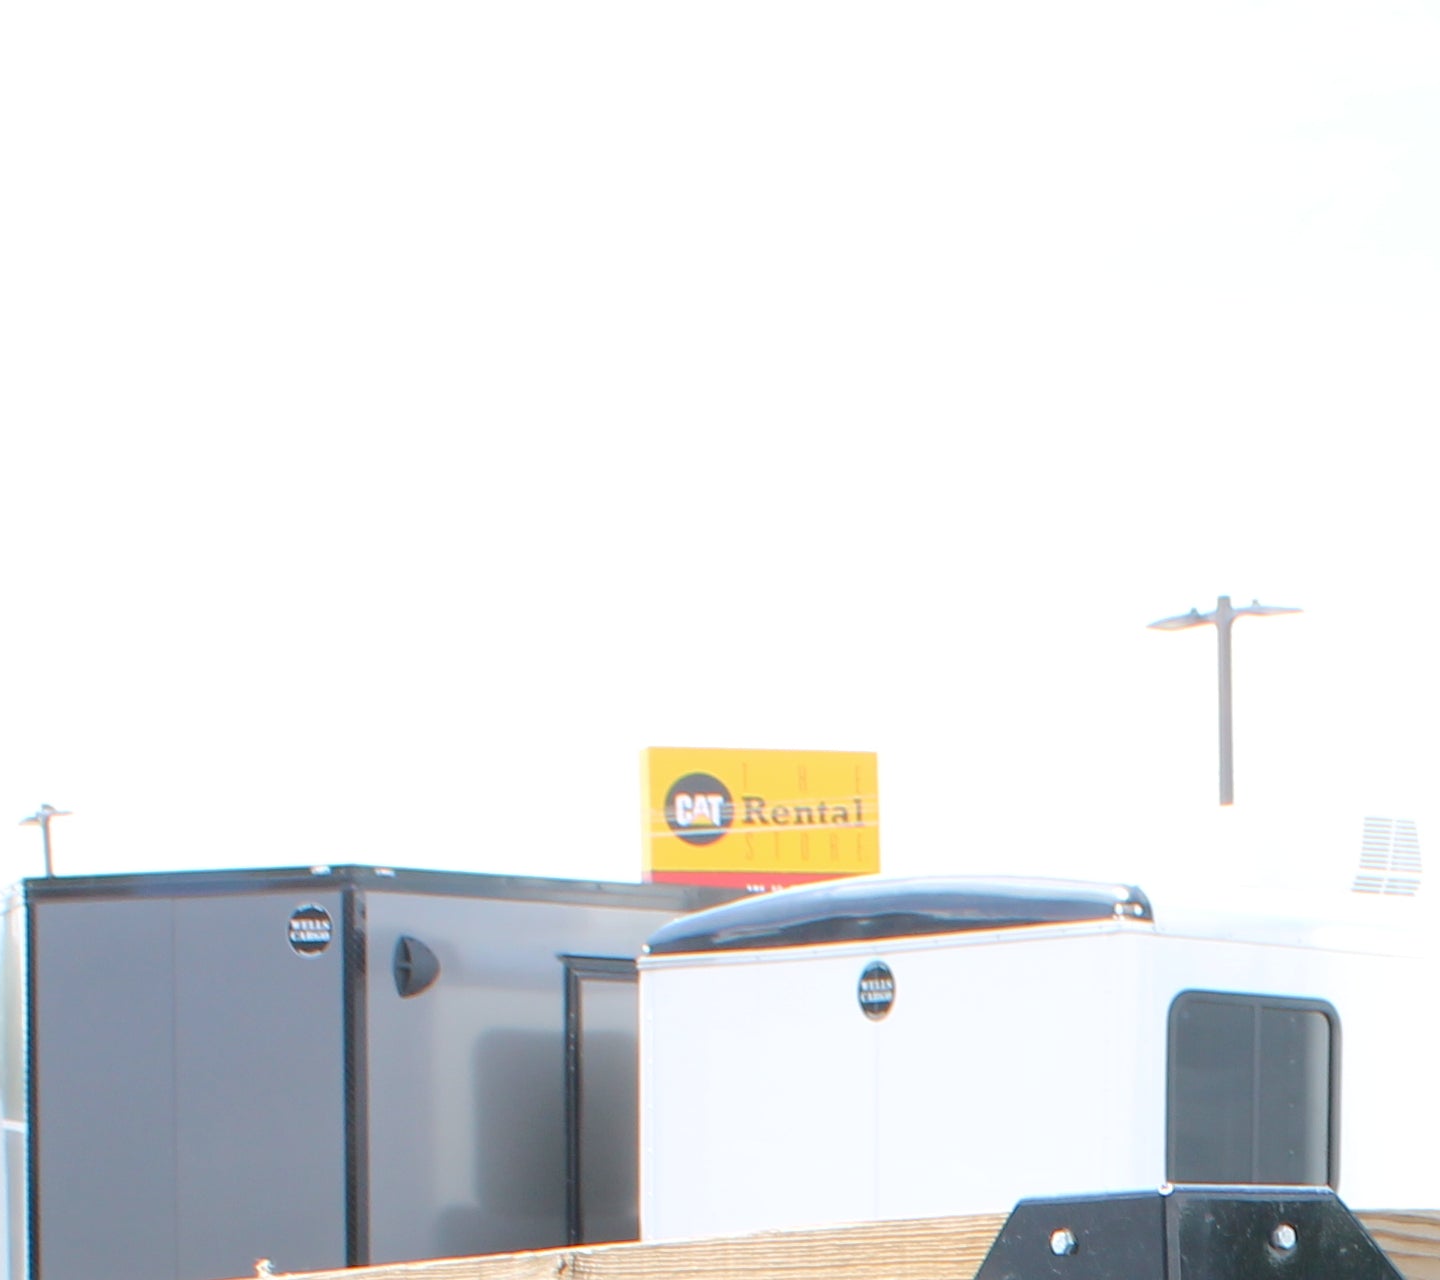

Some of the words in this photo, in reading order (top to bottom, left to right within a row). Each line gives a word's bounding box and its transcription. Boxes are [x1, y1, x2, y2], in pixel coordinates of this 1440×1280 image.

[674, 792, 724, 827] CAT
[742, 795, 865, 828] Rental
[744, 831, 863, 863] STORE
[290, 918, 331, 930] WELLS
